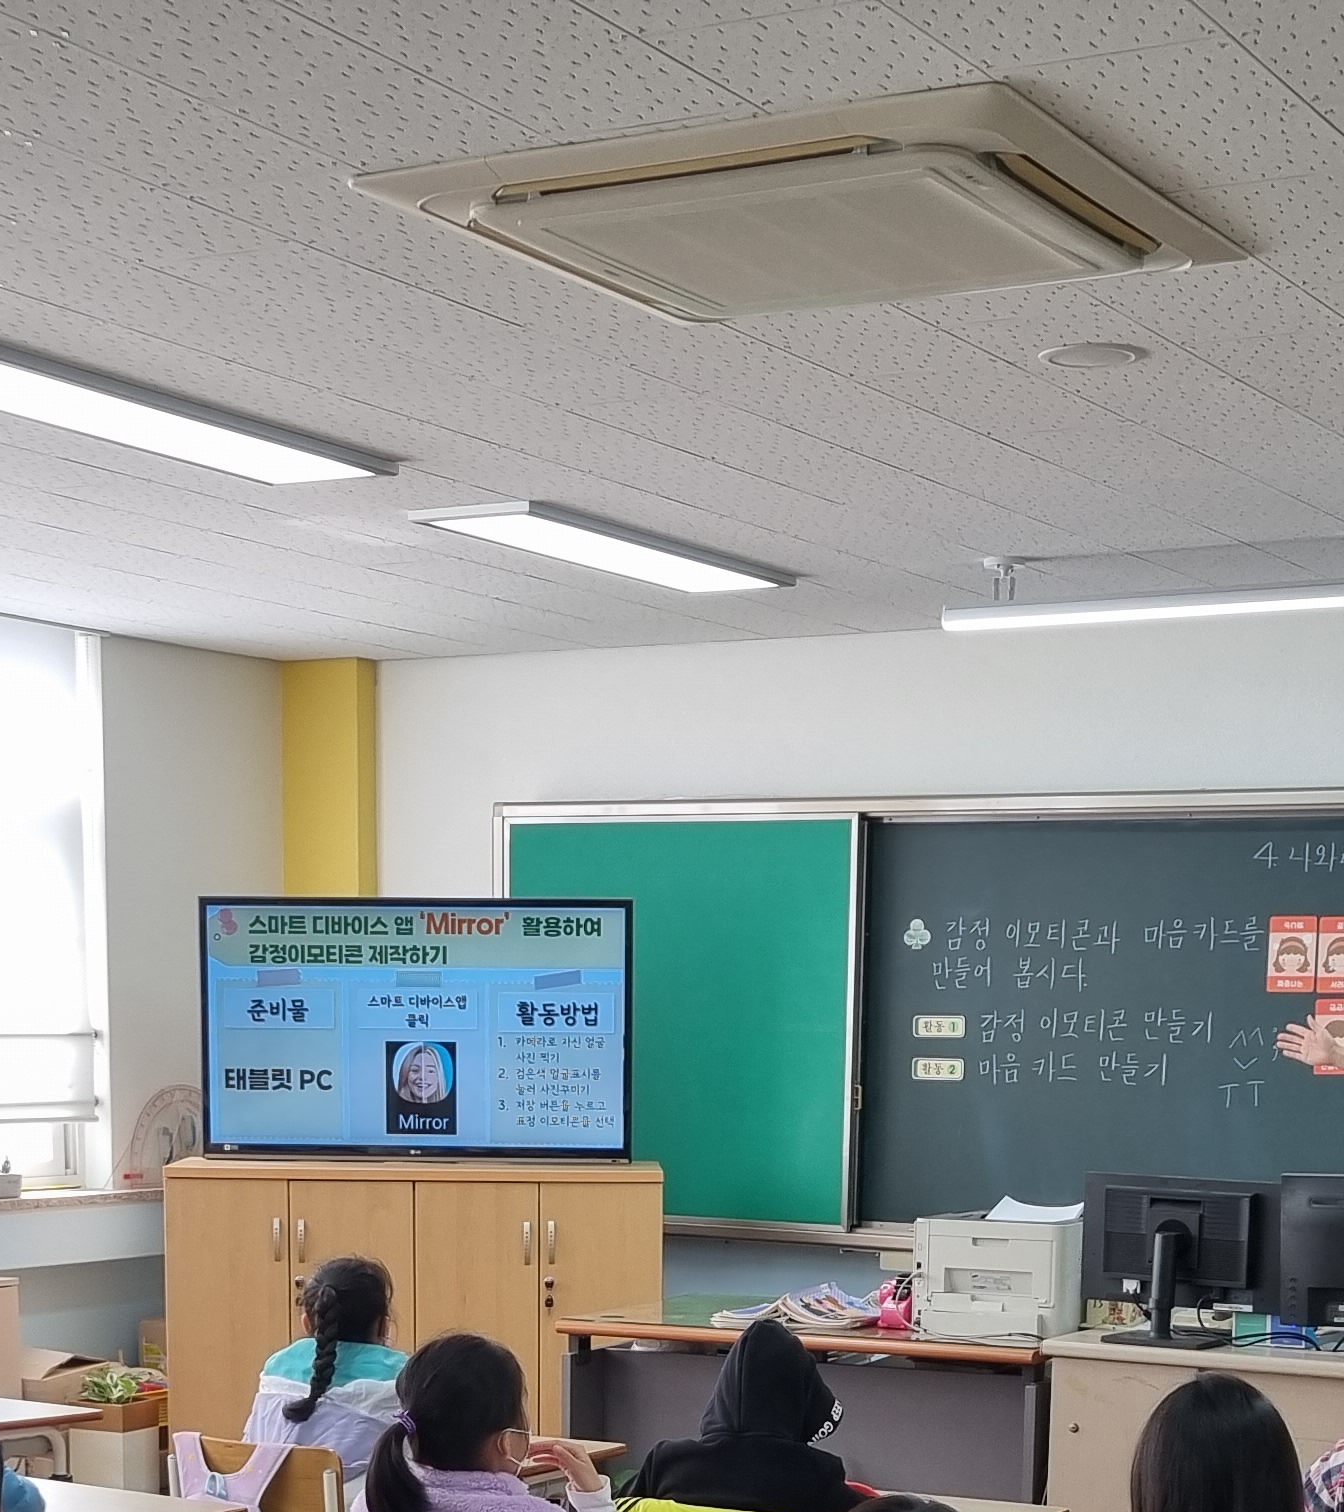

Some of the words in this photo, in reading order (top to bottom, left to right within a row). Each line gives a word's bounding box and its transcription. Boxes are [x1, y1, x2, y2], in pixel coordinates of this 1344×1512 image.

[1253, 841, 1279, 870] 4.
[248, 915, 308, 937] 스마트
[312, 914, 389, 937] 디바이스
[393, 914, 414, 937] 앱
[522, 916, 602, 938] 활용하여
[946, 917, 991, 952] 감정
[1004, 918, 1121, 954] 이모티콘과
[248, 943, 364, 966] 감정이모티콘
[368, 944, 448, 966] 제작하기
[932, 958, 992, 991] 만들어
[1014, 956, 1089, 992] 봅시다.
[247, 998, 310, 1023] 준비물
[367, 995, 405, 1010] 스마트
[516, 1001, 600, 1027] 활동방법
[979, 1009, 1026, 1044] 감정
[1039, 1008, 1128, 1043] 이모티콘
[1143, 1007, 1214, 1044] 만들기
[562, 1036, 581, 1048] 자신
[516, 1052, 536, 1064] 사진
[978, 1052, 1021, 1086] 마음
[1031, 1051, 1078, 1082] 카드
[1098, 1050, 1168, 1087] 만들기
[224, 1067, 294, 1092] 태블릿
[299, 1070, 333, 1091] PC
[516, 1068, 546, 1080] 검은색
[516, 1100, 535, 1111] 저장
[574, 1100, 607, 1111] 누르고
[399, 1113, 449, 1131] Mirror
